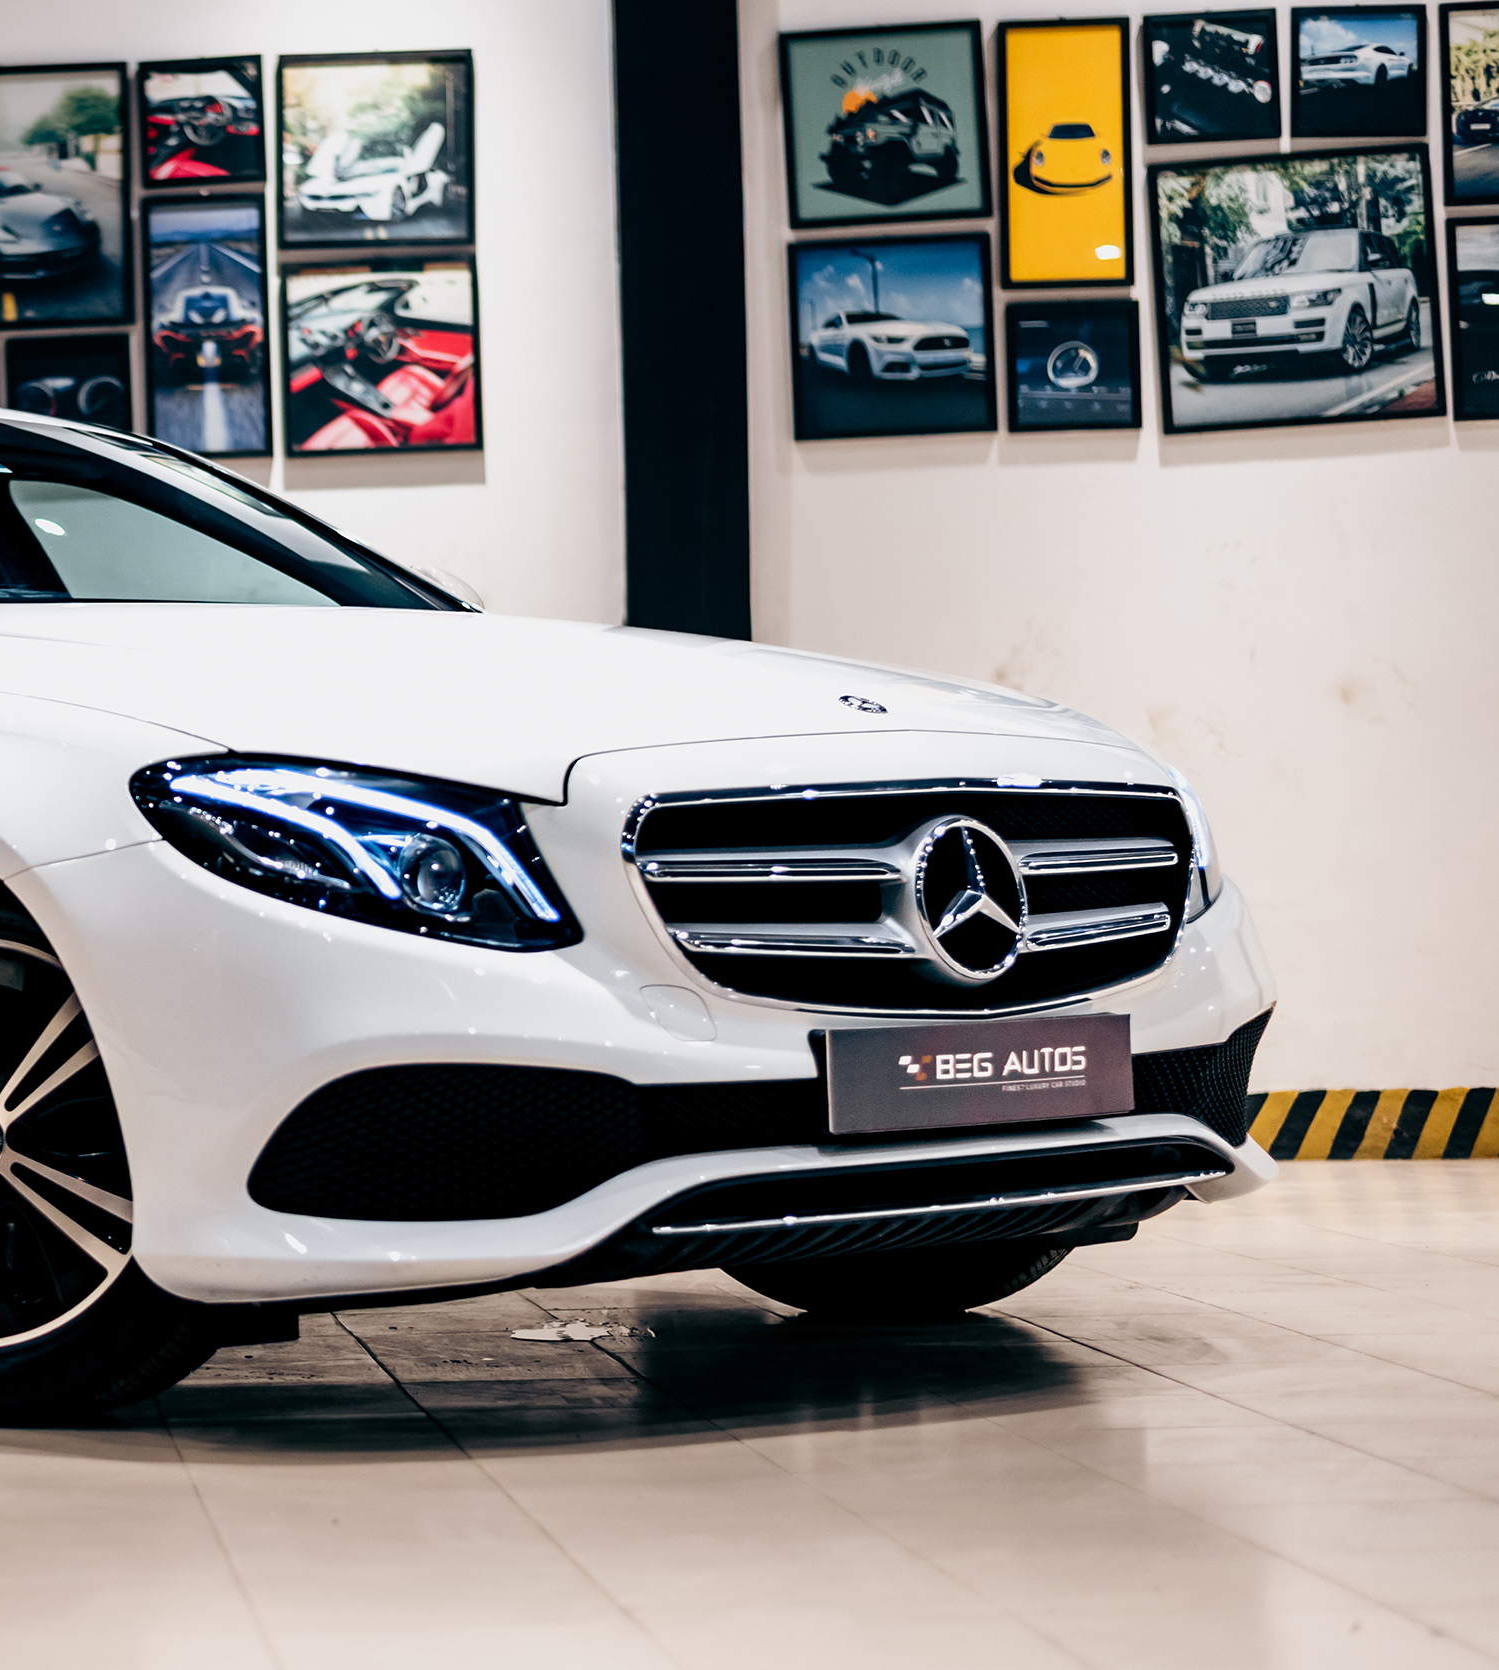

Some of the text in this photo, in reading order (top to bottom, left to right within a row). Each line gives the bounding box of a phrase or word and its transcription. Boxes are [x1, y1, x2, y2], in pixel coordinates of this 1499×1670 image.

[935, 1046, 1086, 1080] BEG AUTOS
[1026, 1082, 1050, 1090] LUXURY
[1051, 1081, 1064, 1089] CAR
[1064, 1079, 1086, 1087] STUDIO
